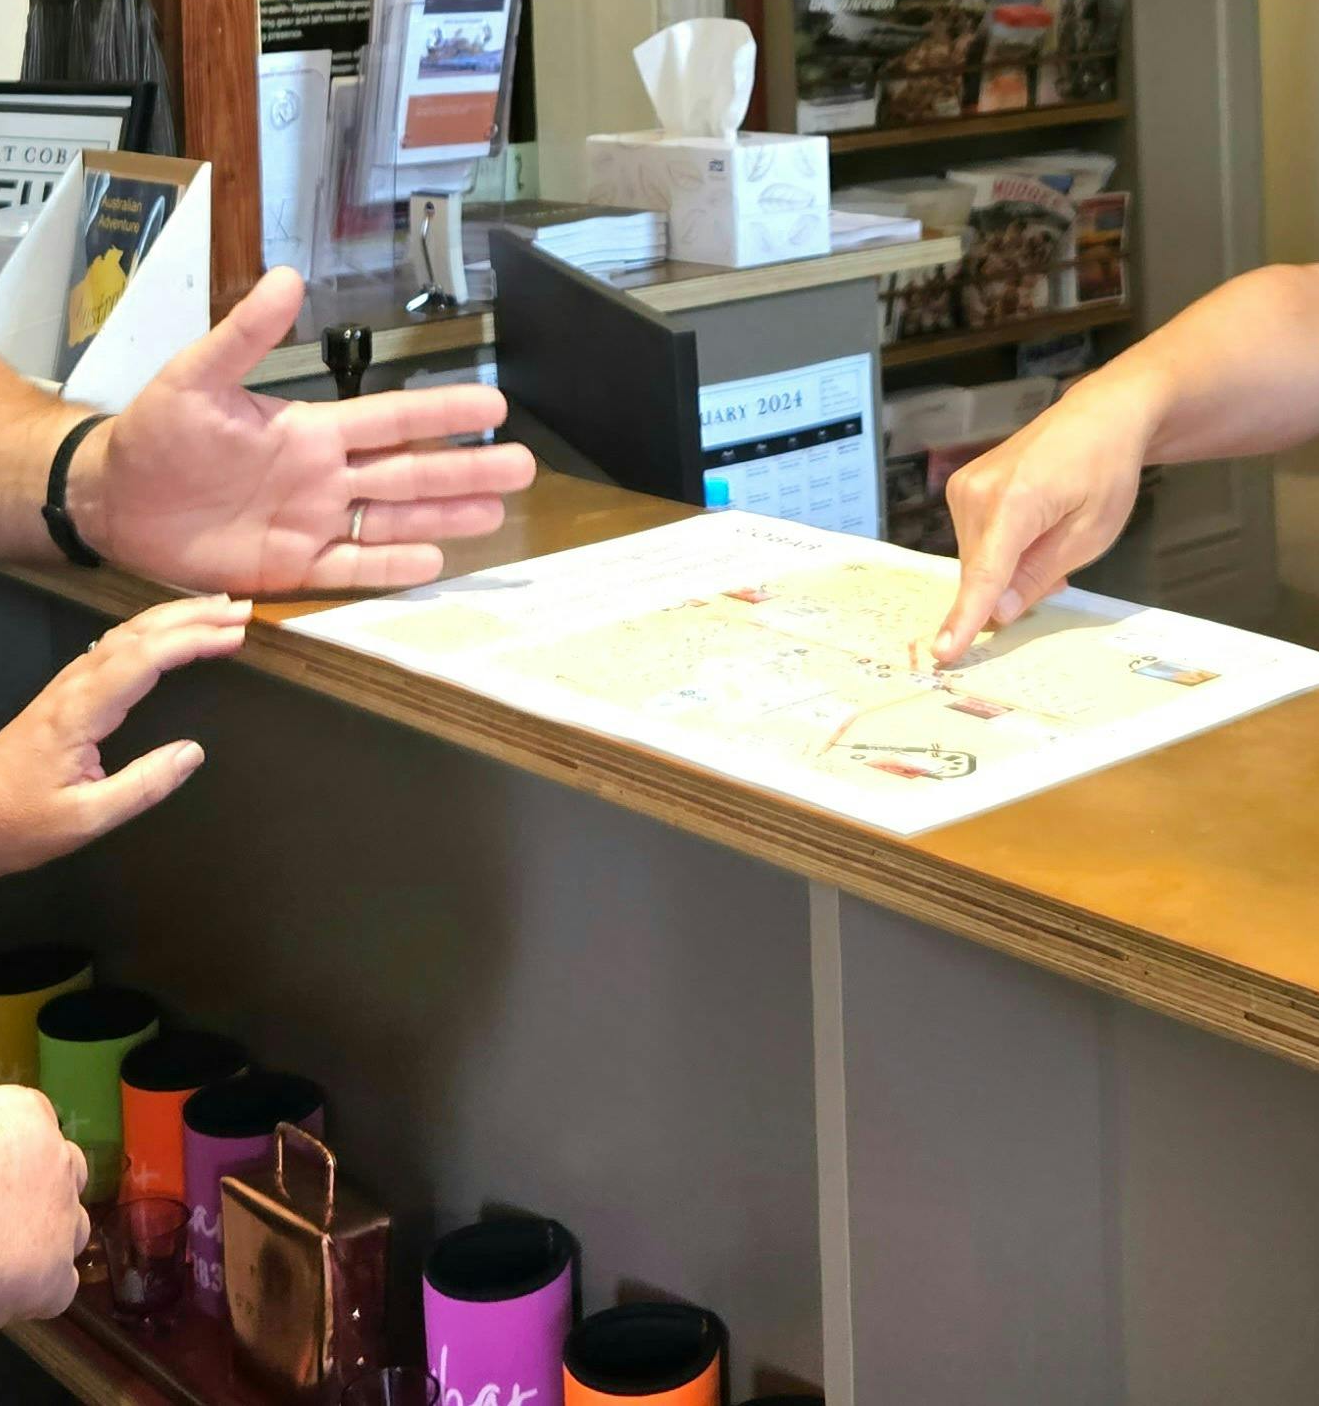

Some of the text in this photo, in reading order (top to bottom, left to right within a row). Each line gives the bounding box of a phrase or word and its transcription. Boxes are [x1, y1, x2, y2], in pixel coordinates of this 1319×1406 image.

[102, 195, 142, 213] Australian
[97, 214, 141, 234] Adventure
[757, 389, 803, 416] 2024
